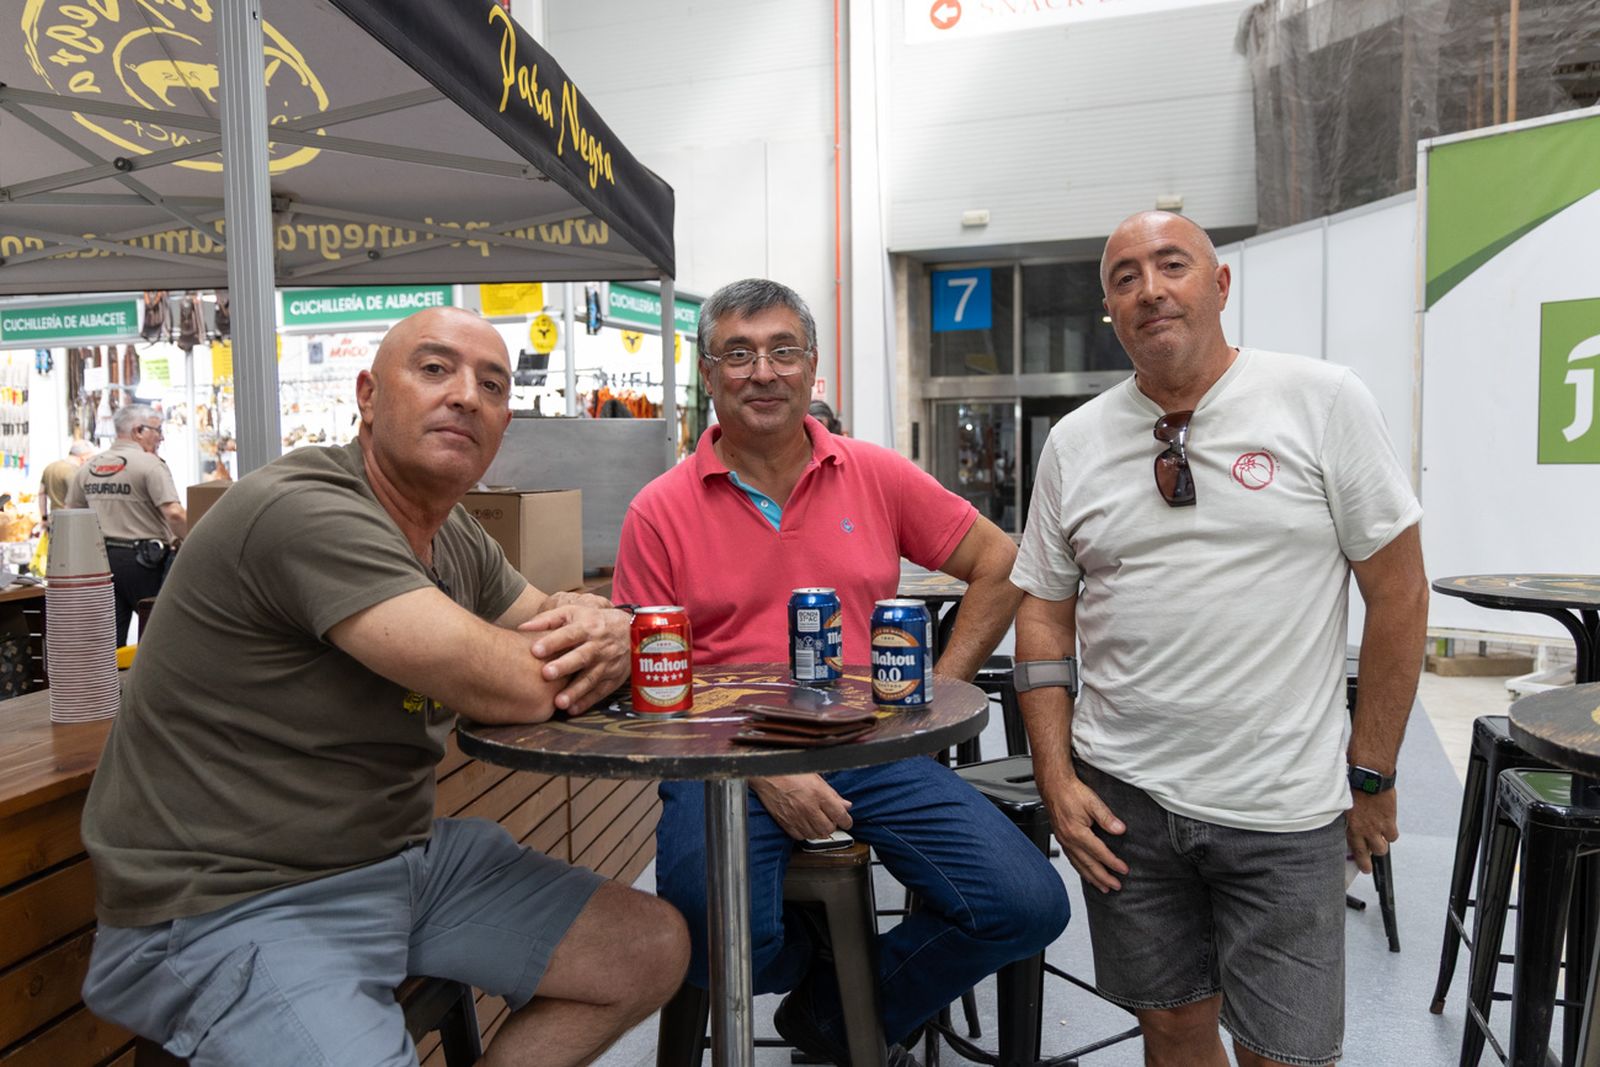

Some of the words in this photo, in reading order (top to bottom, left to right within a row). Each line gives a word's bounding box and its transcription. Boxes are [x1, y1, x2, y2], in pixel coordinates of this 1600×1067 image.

[489, 4, 554, 129] Pata
[557, 80, 615, 190] Negra
[289, 294, 364, 316] CUCHILLERÍA
[365, 295, 384, 310] DE
[384, 291, 444, 309] ALBACETE
[609, 292, 655, 314] CUCHILLERÍA
[948, 277, 978, 323] 7
[3, 314, 62, 332] CUCHILLERÍA
[63, 315, 78, 329] DE
[79, 311, 126, 328] ALBACETE
[638, 657, 688, 673] Mahou
[871, 650, 916, 666] Mahou
